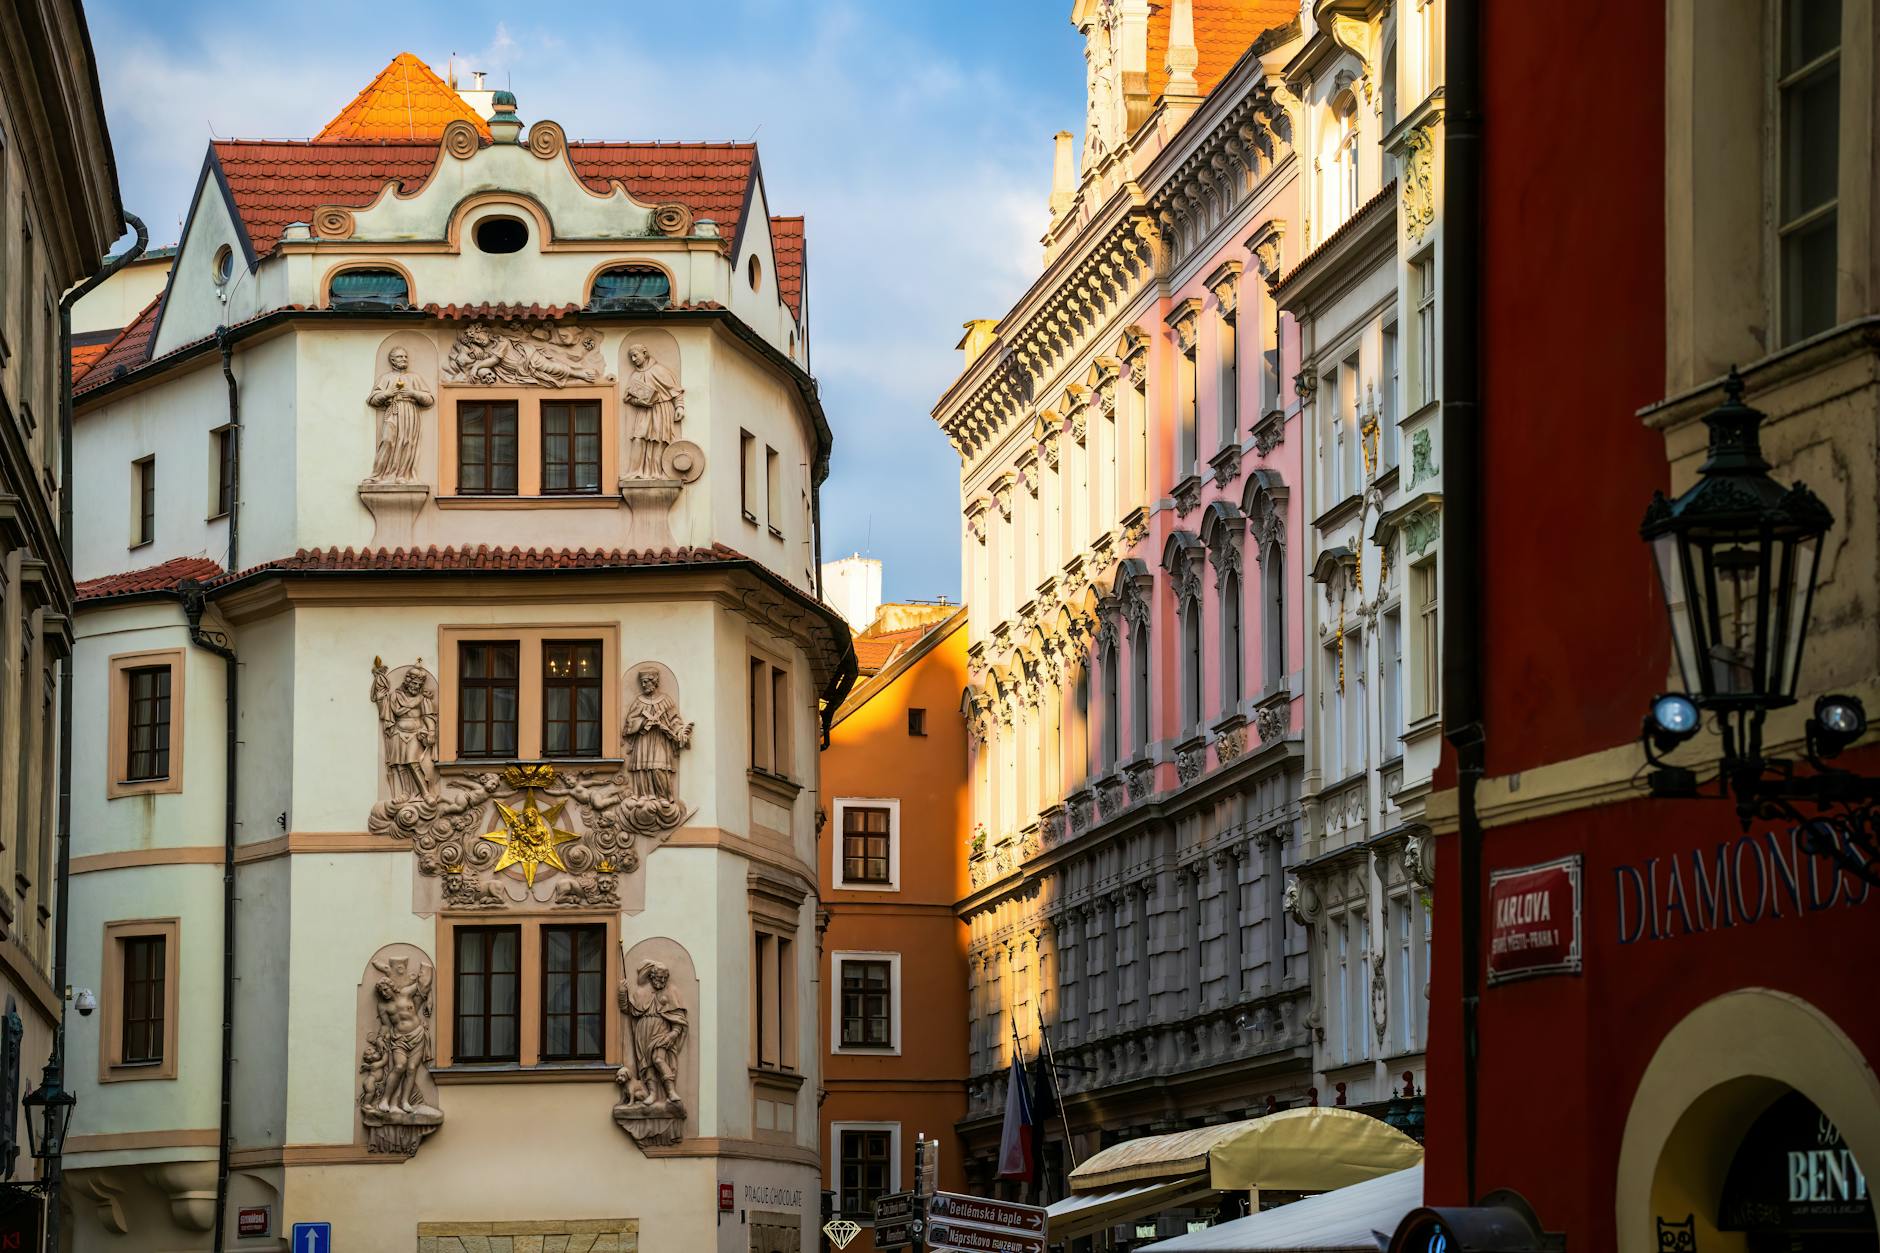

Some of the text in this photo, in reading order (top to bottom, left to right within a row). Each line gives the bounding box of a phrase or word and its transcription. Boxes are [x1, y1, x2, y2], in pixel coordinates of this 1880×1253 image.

[1612, 820, 1871, 945] DIAMONDS
[1496, 890, 1551, 929] KARLOVA
[744, 1185, 769, 1204] PRAGUE
[769, 1187, 802, 1207] CHOCOLATE
[949, 1201, 1023, 1226] Betlémská kaple
[948, 1229, 991, 1248] Náprstkovo
